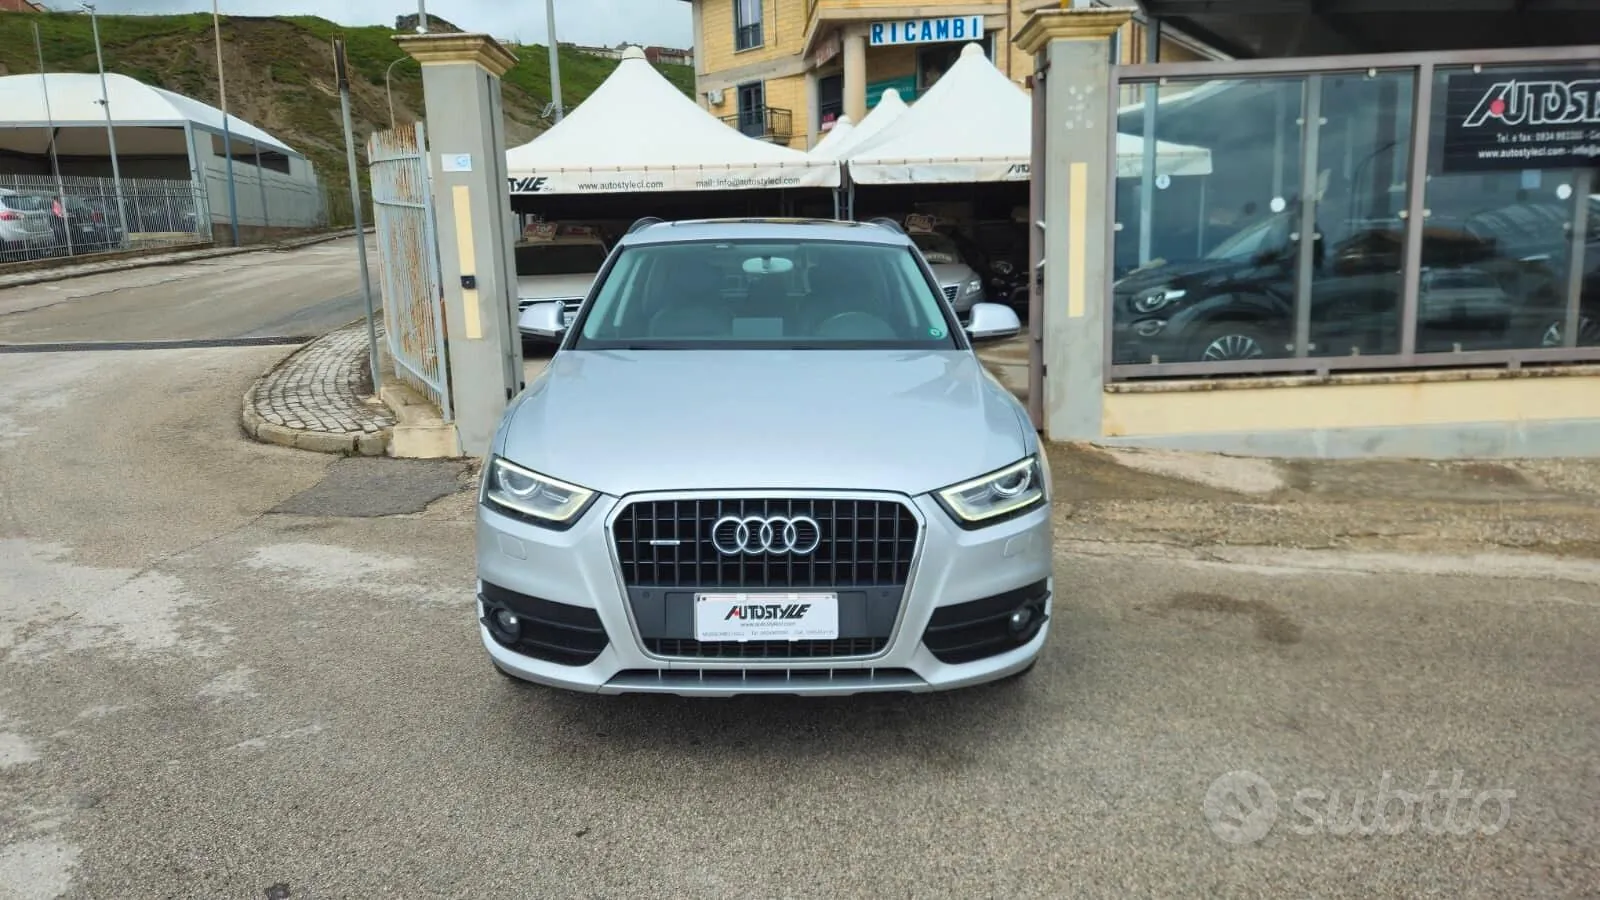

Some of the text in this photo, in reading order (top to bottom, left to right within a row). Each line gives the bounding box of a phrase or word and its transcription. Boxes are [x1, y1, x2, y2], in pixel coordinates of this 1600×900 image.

[872, 17, 978, 43] RICAMBI
[1462, 79, 1600, 127] AUTOST
[578, 180, 664, 190] www.autostylecl.com
[724, 604, 811, 620] AUTOSTYLE
